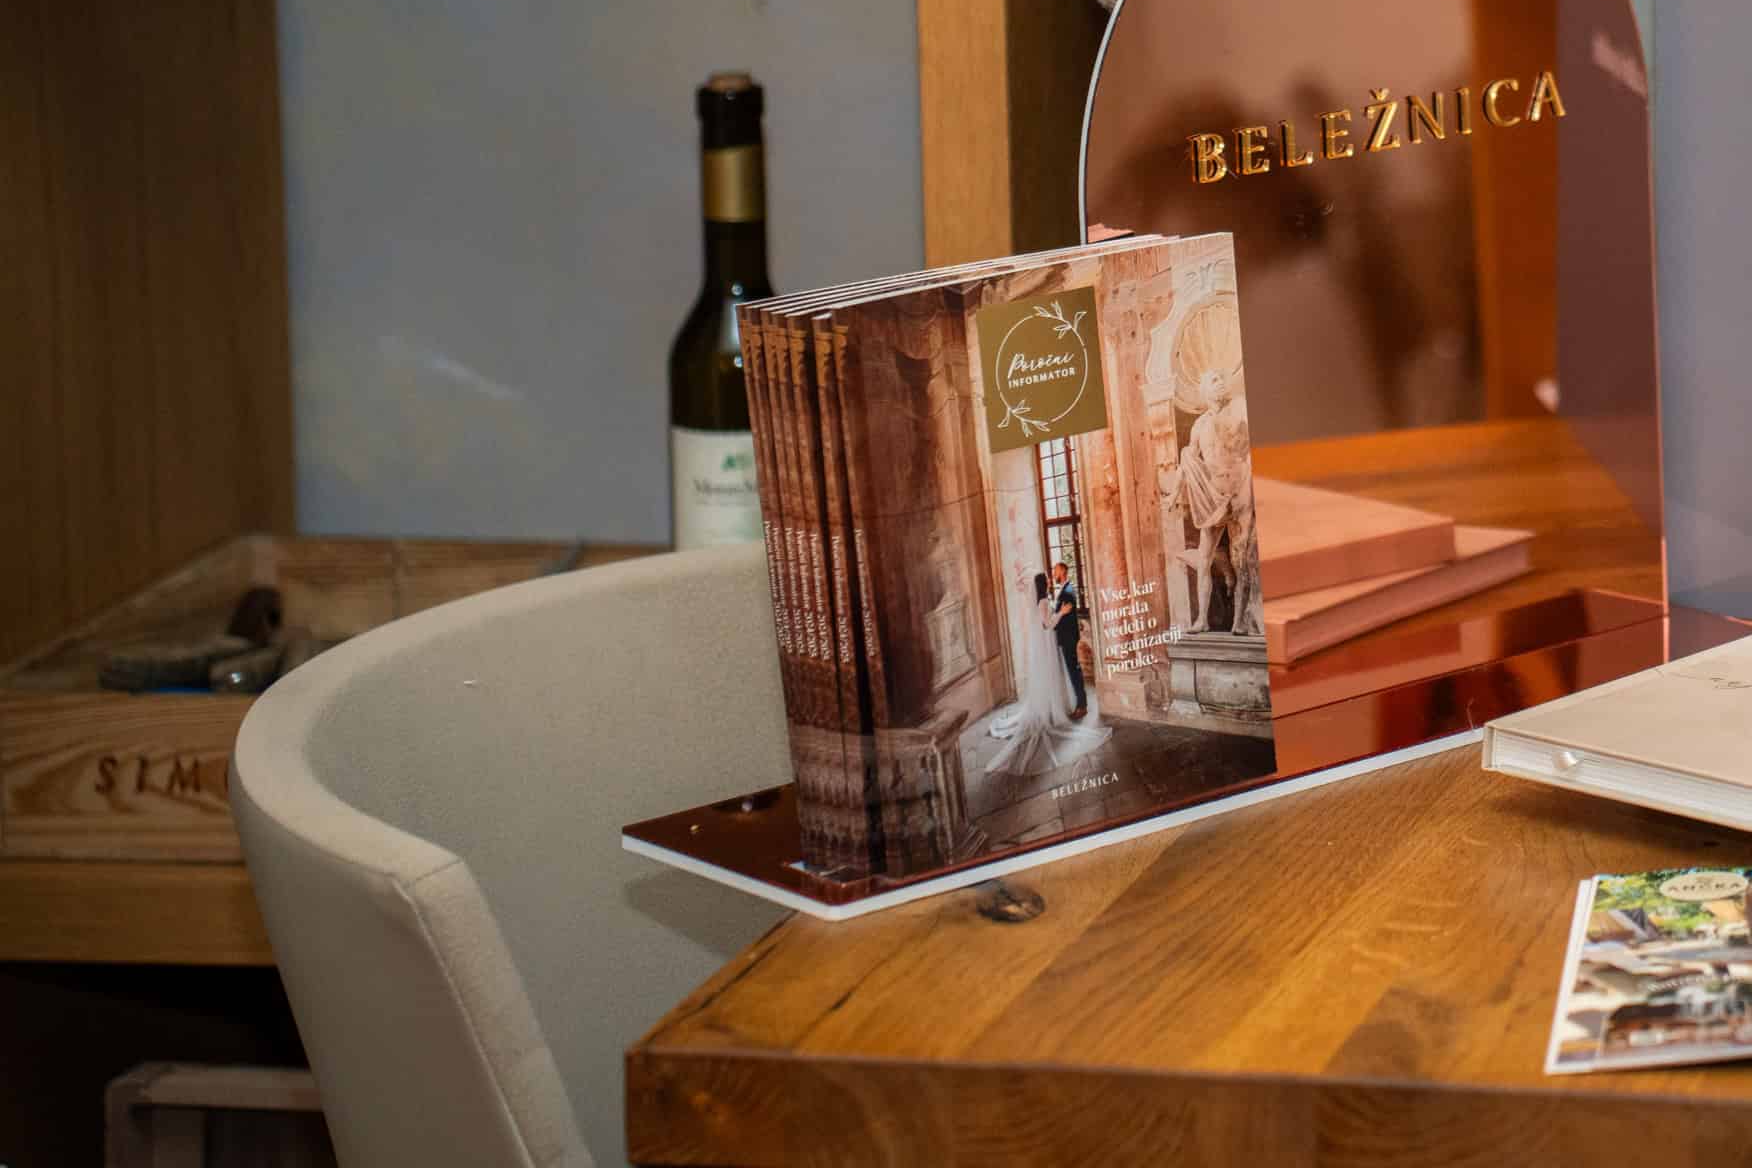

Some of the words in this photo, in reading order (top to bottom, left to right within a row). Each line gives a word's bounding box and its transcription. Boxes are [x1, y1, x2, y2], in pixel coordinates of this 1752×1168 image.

[1187, 70, 1567, 185] BELEŽNICA
[1007, 367, 1076, 390] INFORMATOR
[1131, 579, 1157, 598] kar
[1102, 600, 1149, 621] morata
[1103, 616, 1145, 639] vedeti
[1147, 617, 1157, 630] o
[1105, 625, 1181, 659] organizaciji
[1107, 652, 1159, 681] poroke.
